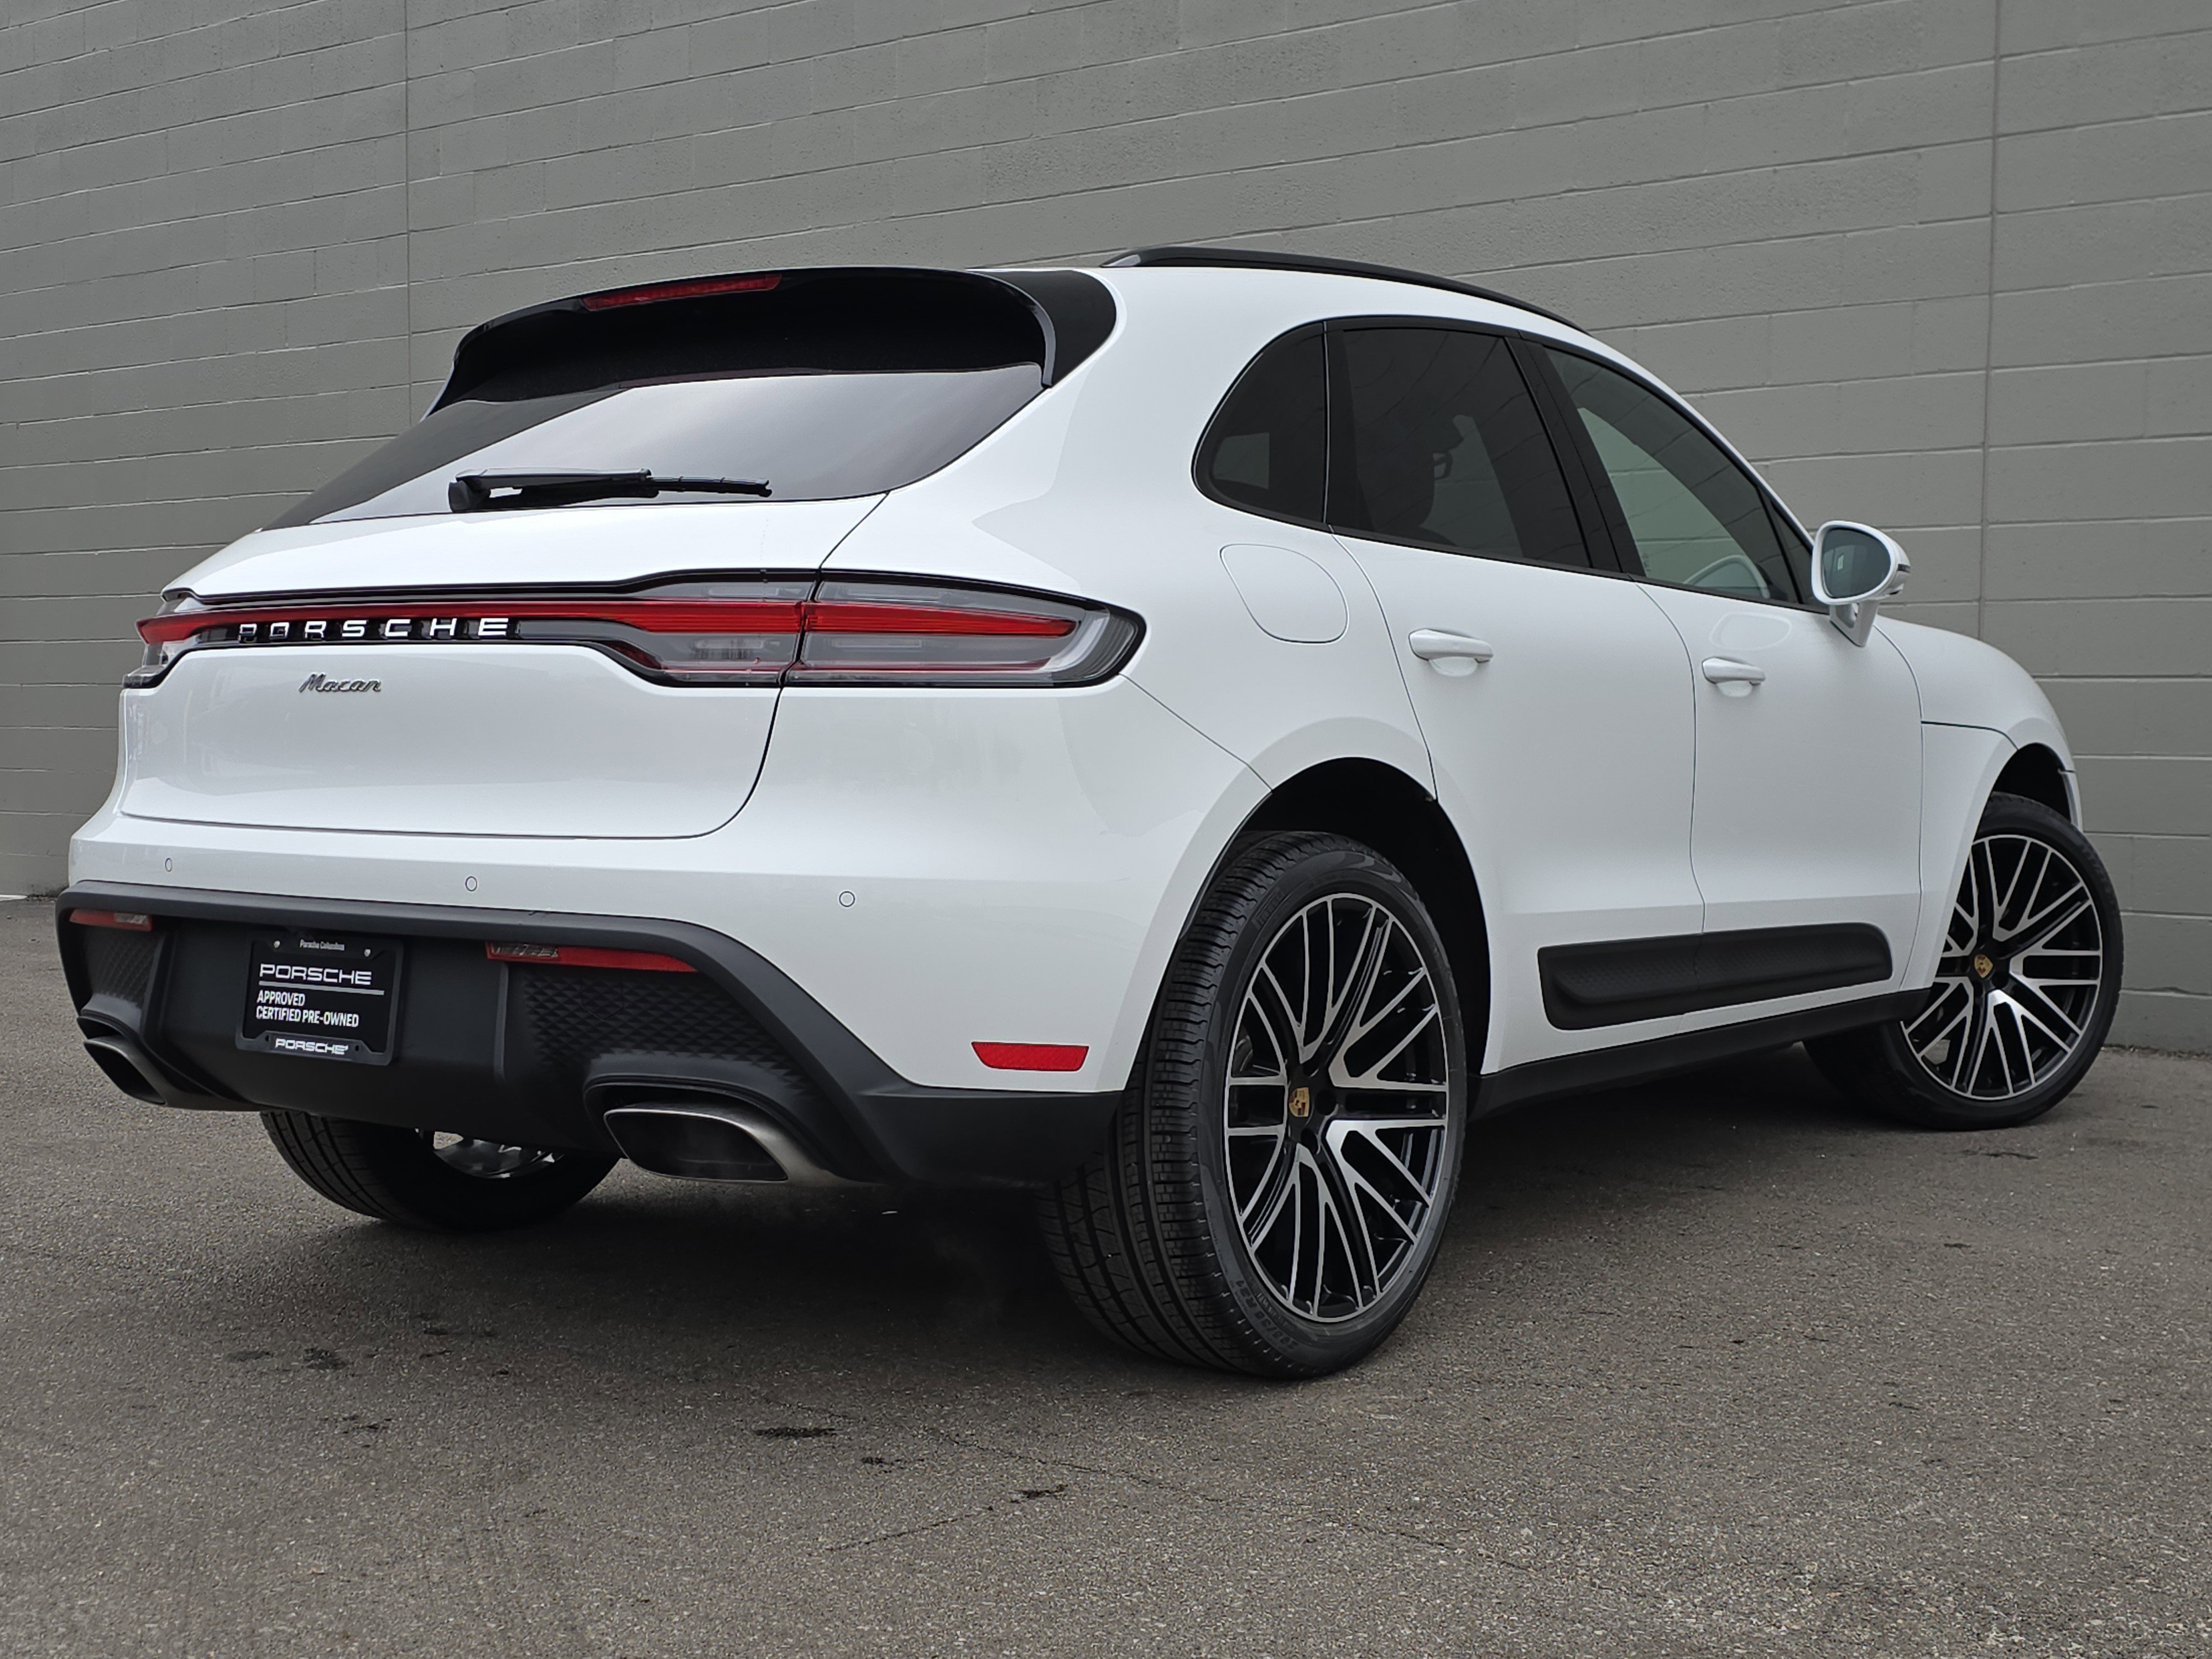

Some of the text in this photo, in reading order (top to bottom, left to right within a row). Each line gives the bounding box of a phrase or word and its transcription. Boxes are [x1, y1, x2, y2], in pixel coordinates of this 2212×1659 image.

[239, 618, 509, 643] PORSCHE
[299, 672, 382, 693] Macan
[259, 963, 372, 985] PORSCHE
[257, 989, 305, 1006] APPROVED
[255, 1005, 359, 1027] CERTIFIED PRE-OWNED
[275, 1038, 348, 1055] PORSCHE
